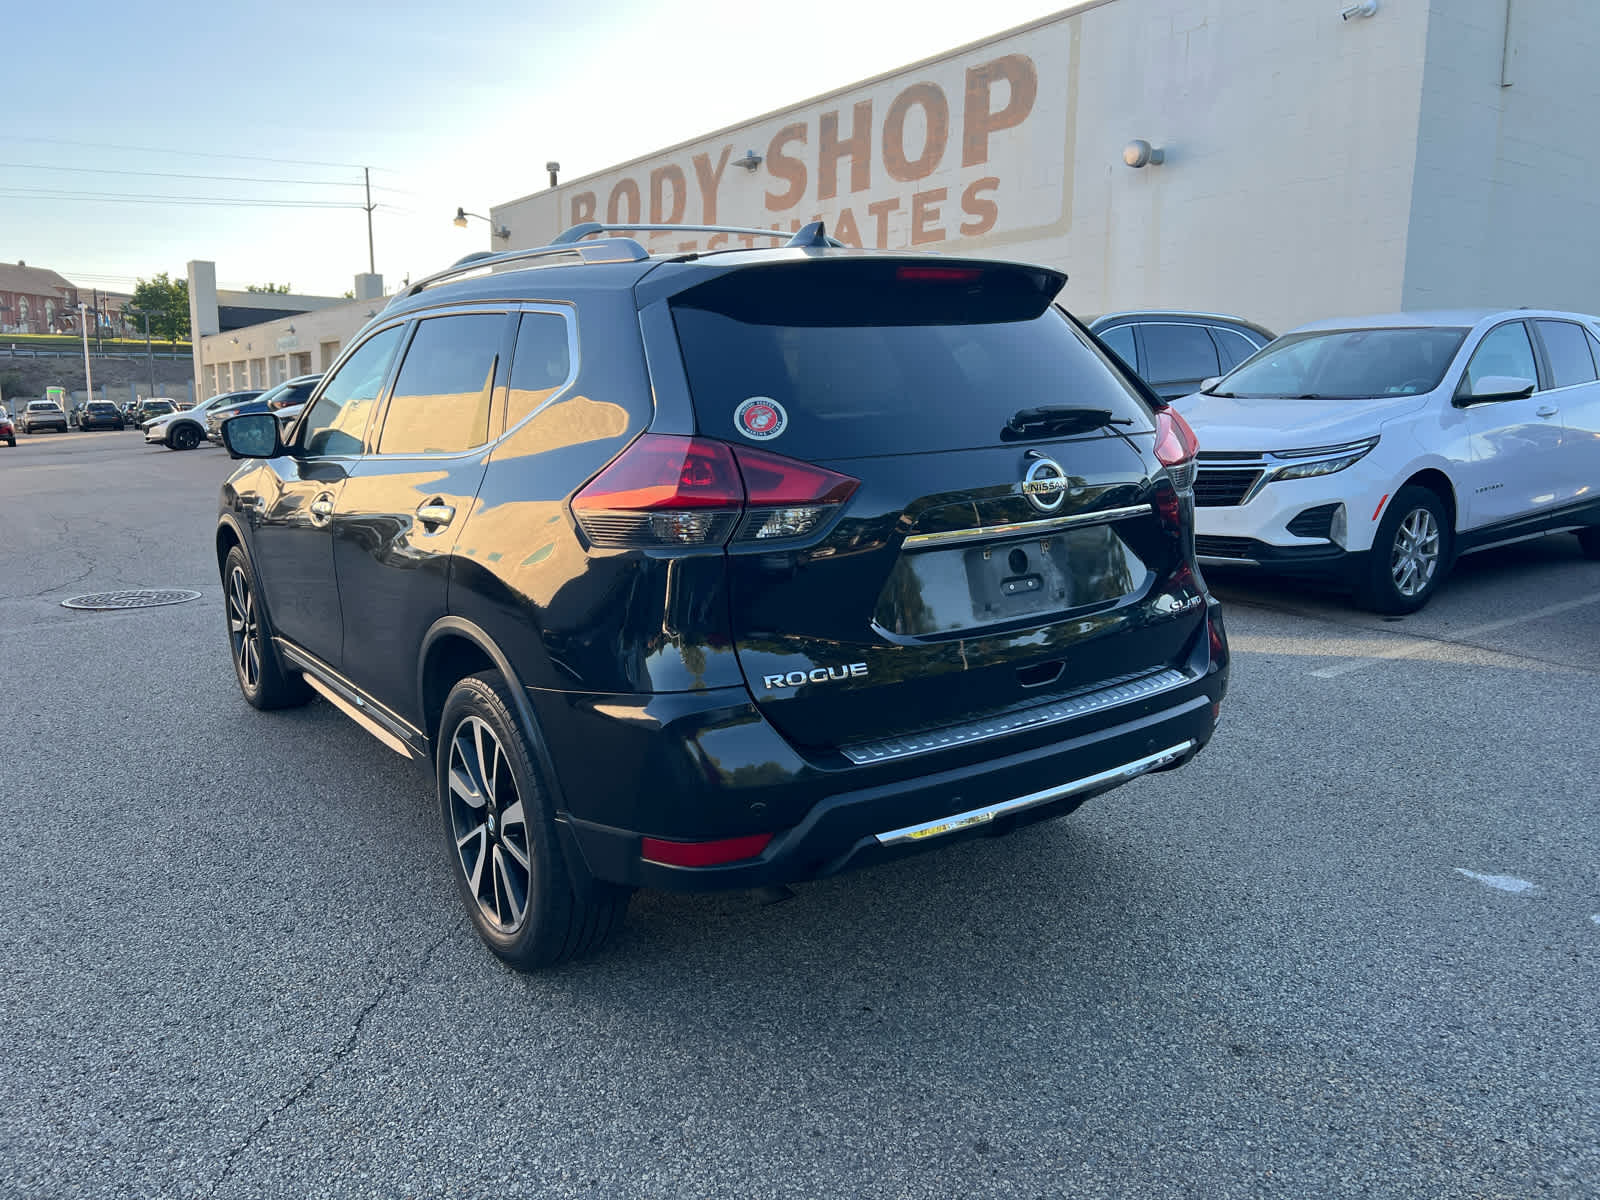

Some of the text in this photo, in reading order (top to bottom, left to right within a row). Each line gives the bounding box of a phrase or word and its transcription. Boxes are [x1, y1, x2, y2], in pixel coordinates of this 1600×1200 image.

[764, 53, 1038, 213] SHOP
[676, 176, 1001, 252] TIATES
[1029, 481, 1066, 493] NISSAN
[763, 661, 869, 689] ROGUE
